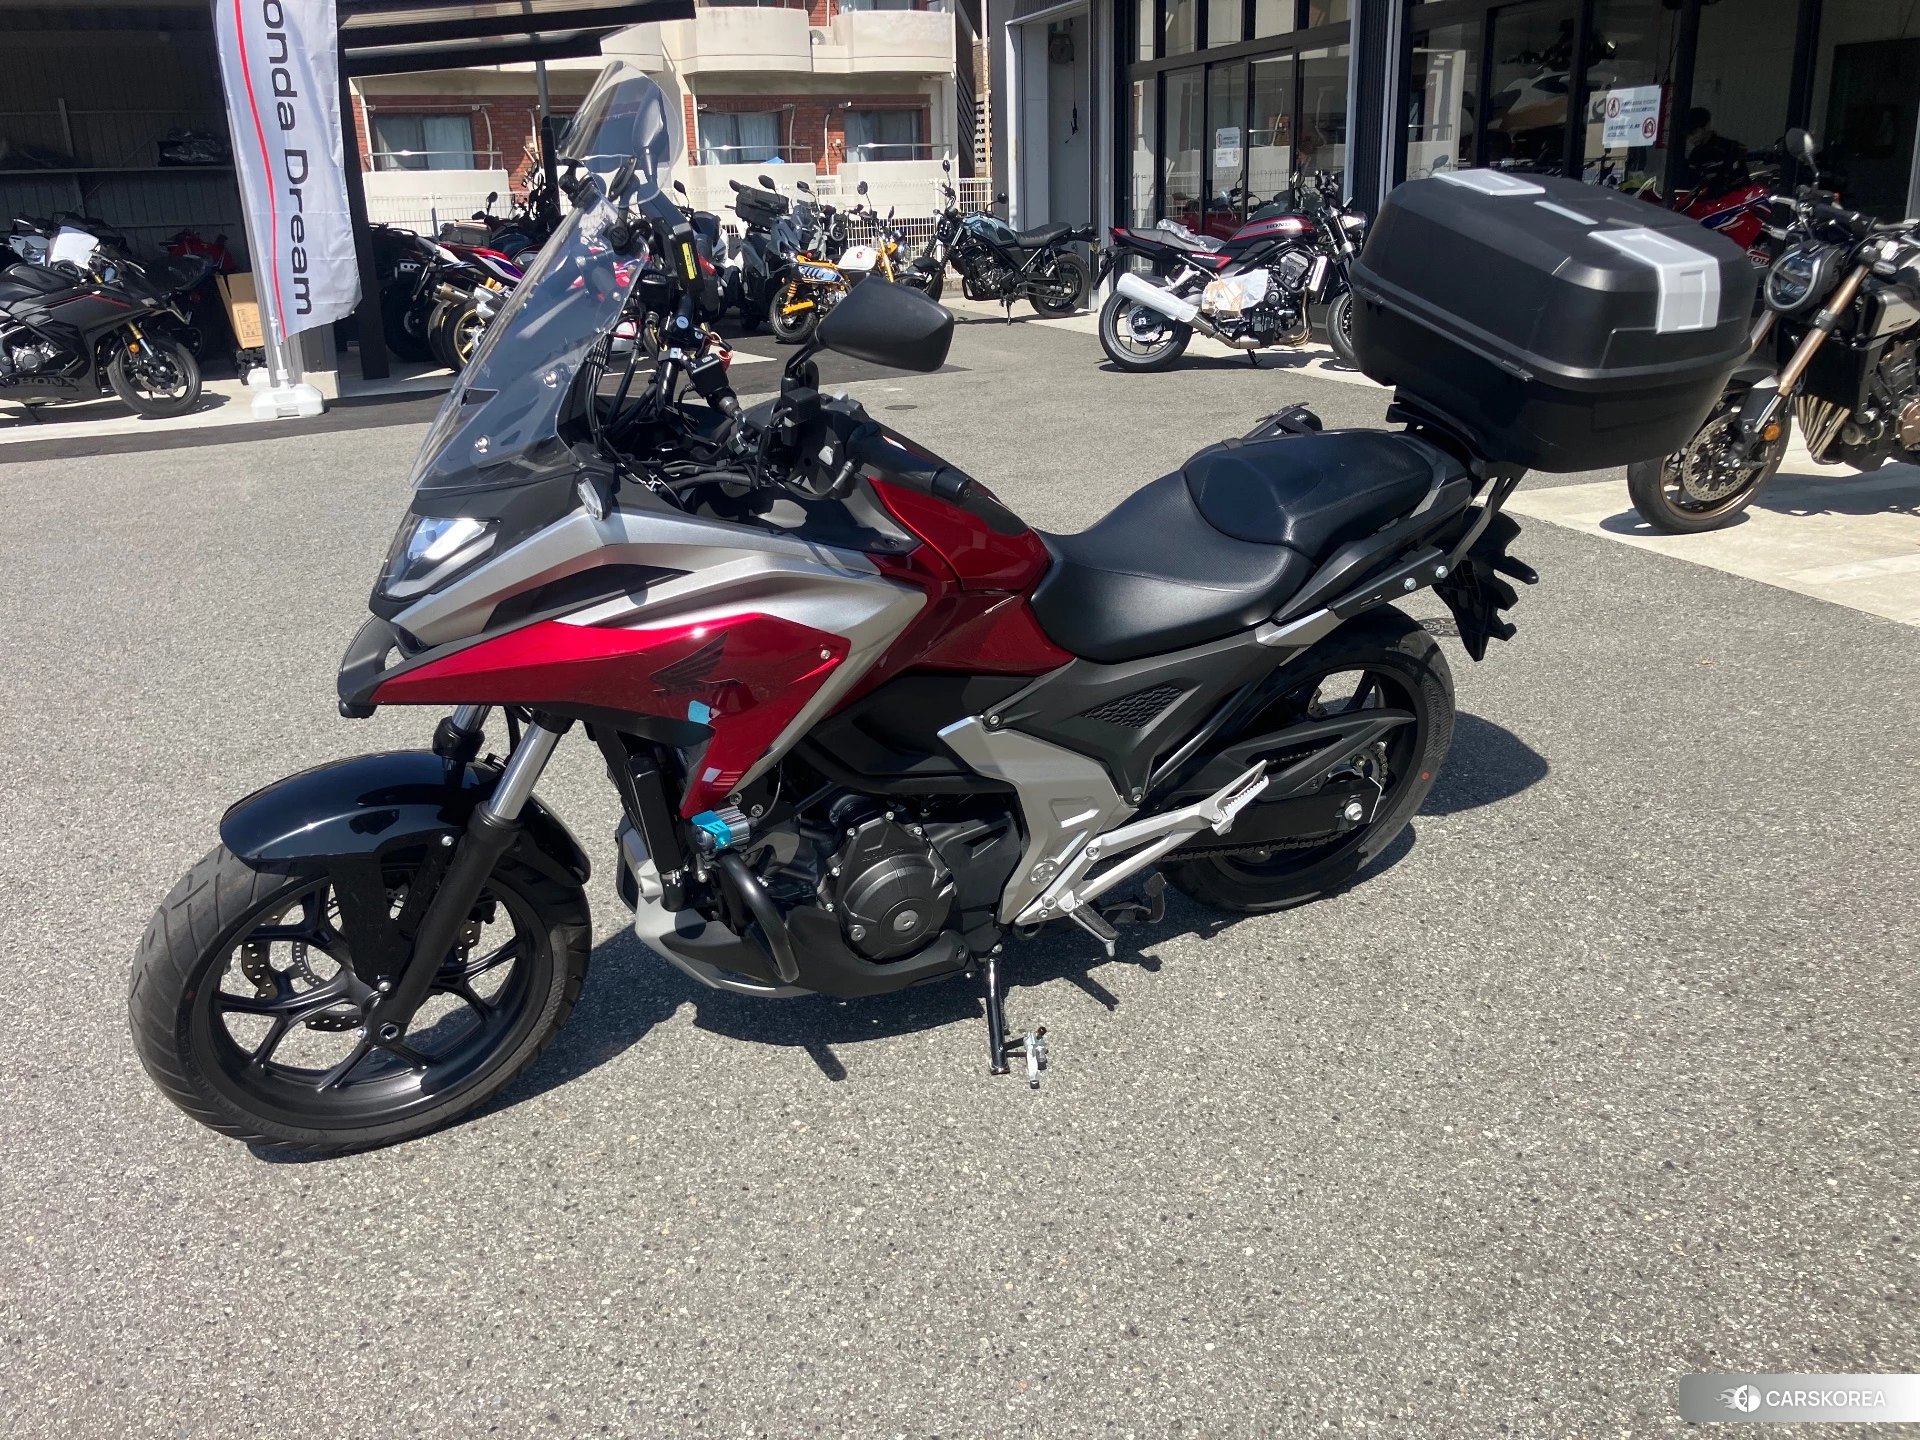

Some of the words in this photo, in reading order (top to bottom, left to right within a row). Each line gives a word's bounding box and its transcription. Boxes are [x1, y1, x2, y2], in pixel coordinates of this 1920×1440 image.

[262, 0, 298, 131] onda
[284, 148, 312, 315] Dream
[1265, 221, 1297, 231] HOND
